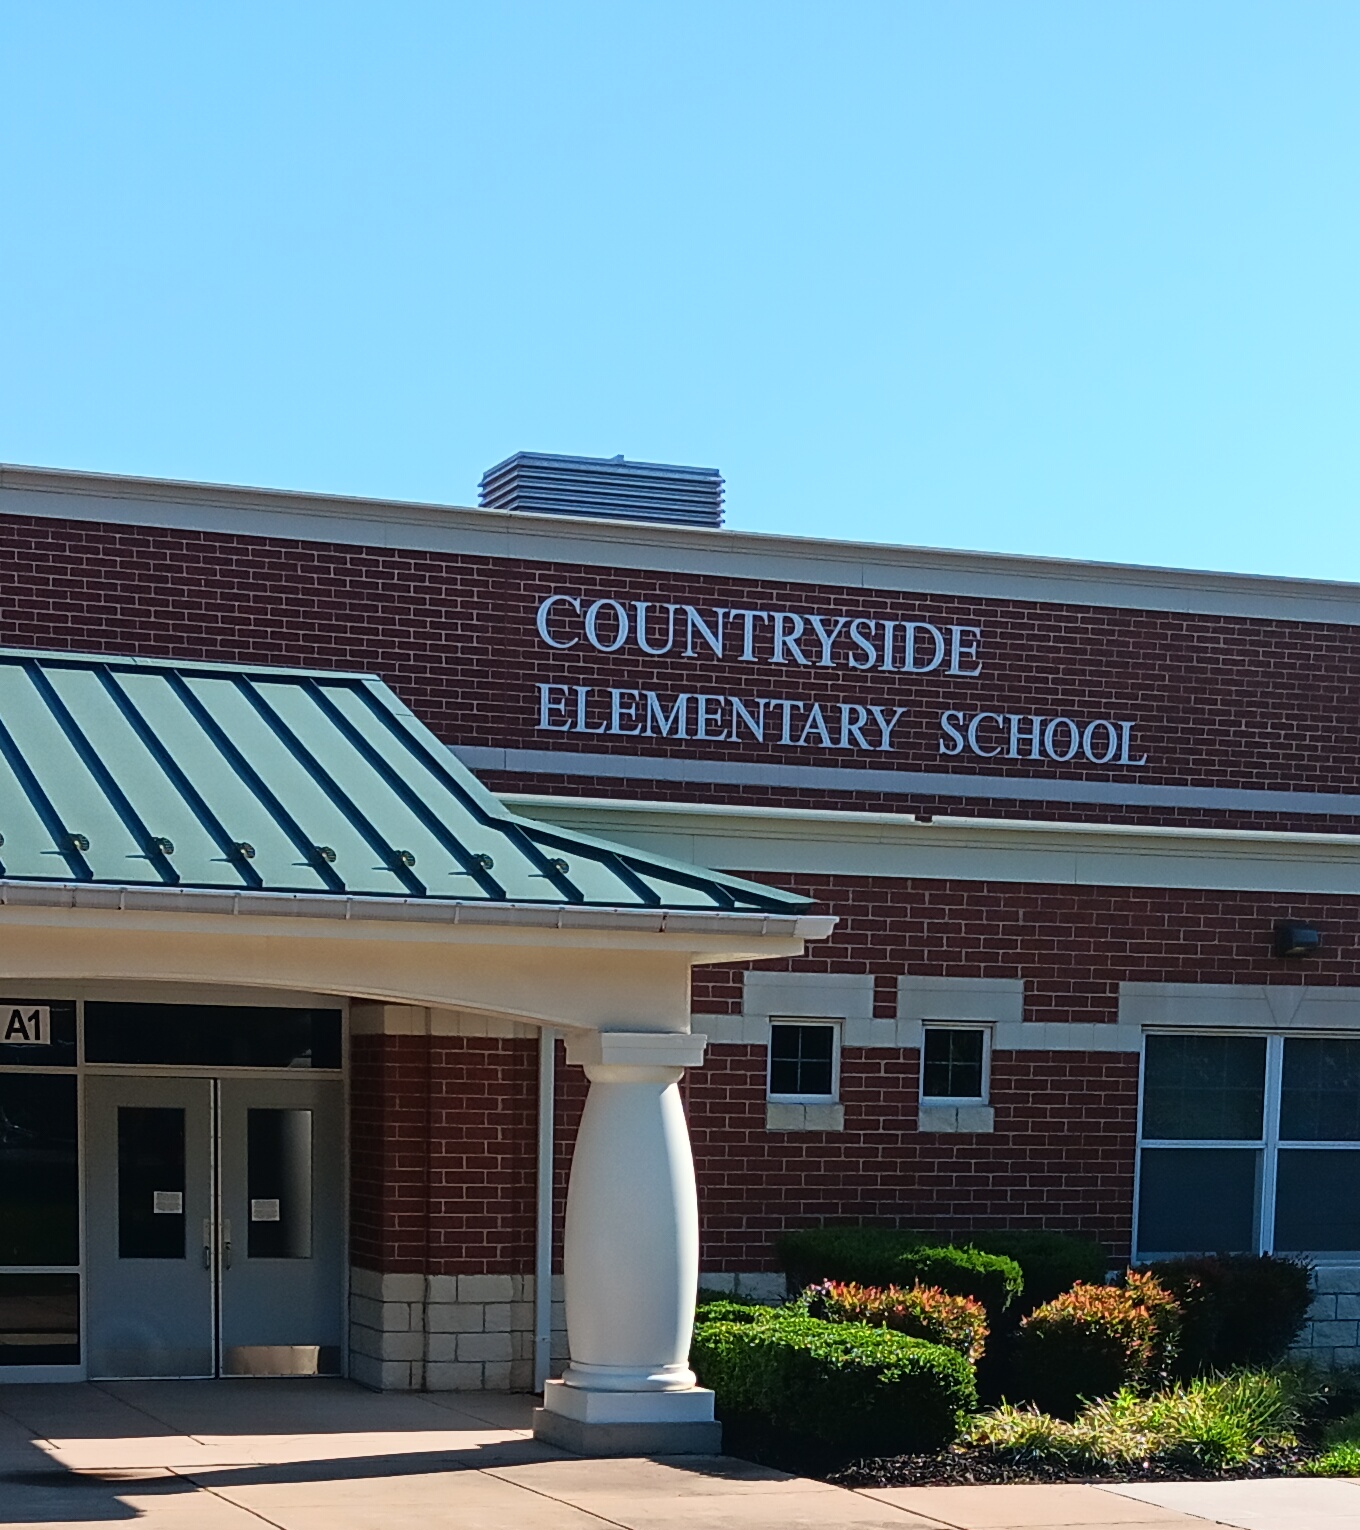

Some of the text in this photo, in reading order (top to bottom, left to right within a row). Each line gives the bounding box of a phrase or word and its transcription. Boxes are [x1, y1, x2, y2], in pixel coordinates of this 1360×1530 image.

[536, 594, 983, 677] COUNTRYSIDE
[534, 682, 1148, 766] ELEMENTARY SCHOOL
[4, 1008, 41, 1041] A1
